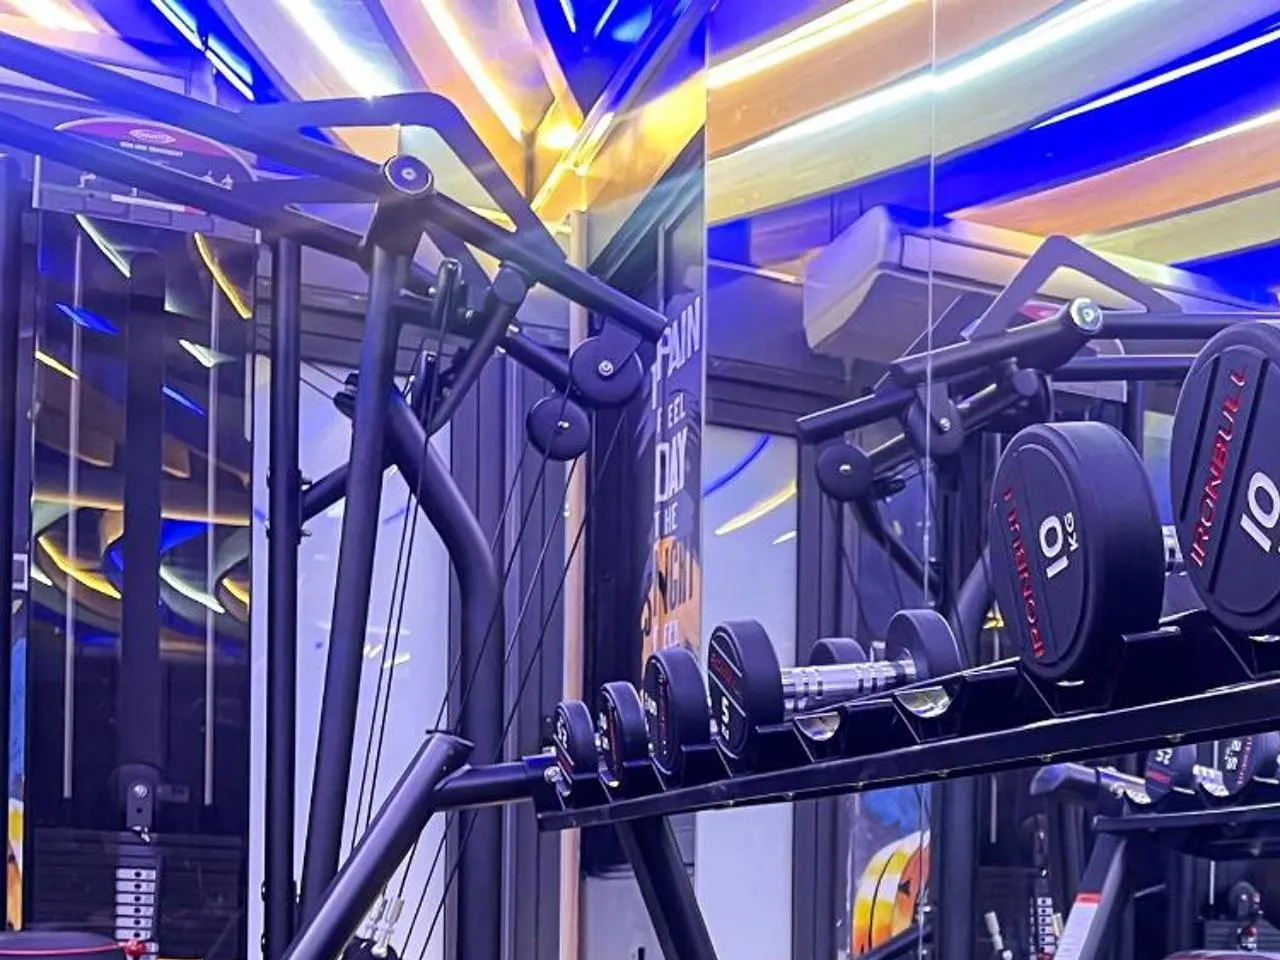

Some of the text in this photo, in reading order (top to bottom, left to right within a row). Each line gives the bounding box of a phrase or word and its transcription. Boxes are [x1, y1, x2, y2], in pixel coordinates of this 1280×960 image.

[1189, 367, 1248, 567] IRONBULL
[1038, 514, 1069, 579] 10
[1064, 511, 1080, 551] KG
[1240, 471, 1280, 553] 10
